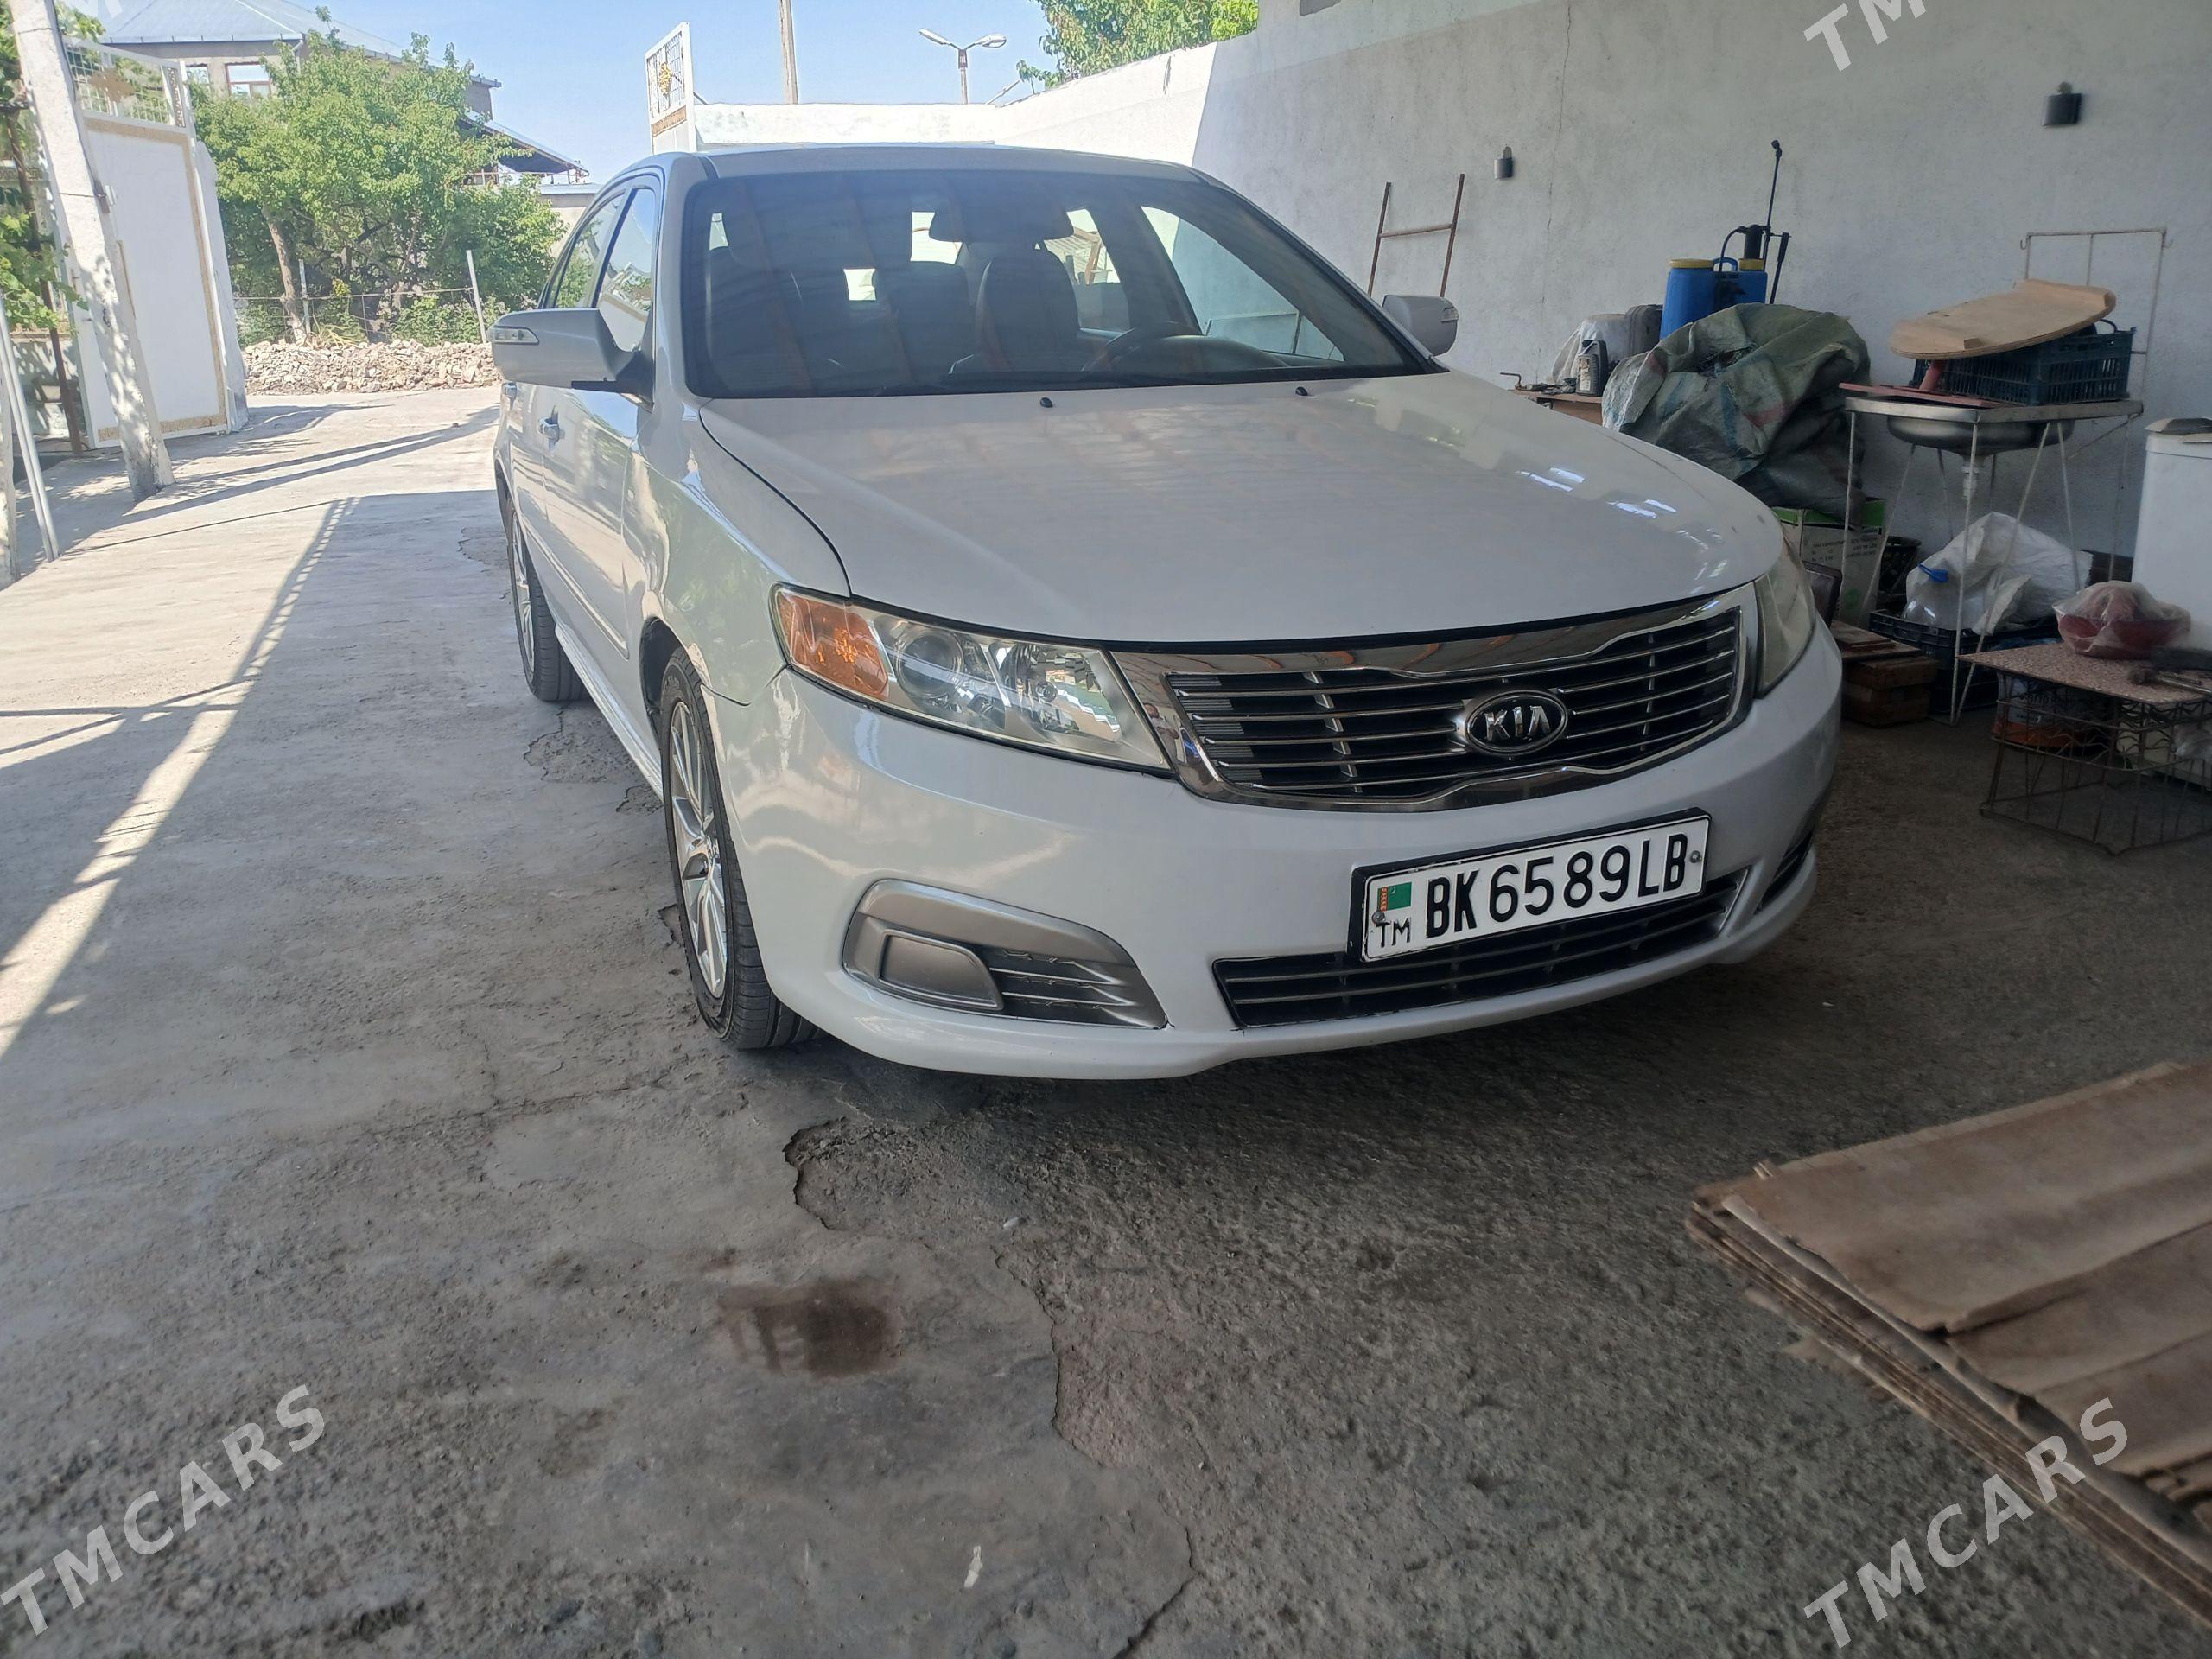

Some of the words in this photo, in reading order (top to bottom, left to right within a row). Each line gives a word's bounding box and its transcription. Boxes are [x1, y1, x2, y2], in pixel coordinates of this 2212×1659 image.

[1484, 704, 1553, 741] KIA
[1426, 833, 1688, 939] BK6589LB
[1376, 917, 1411, 948] TM
